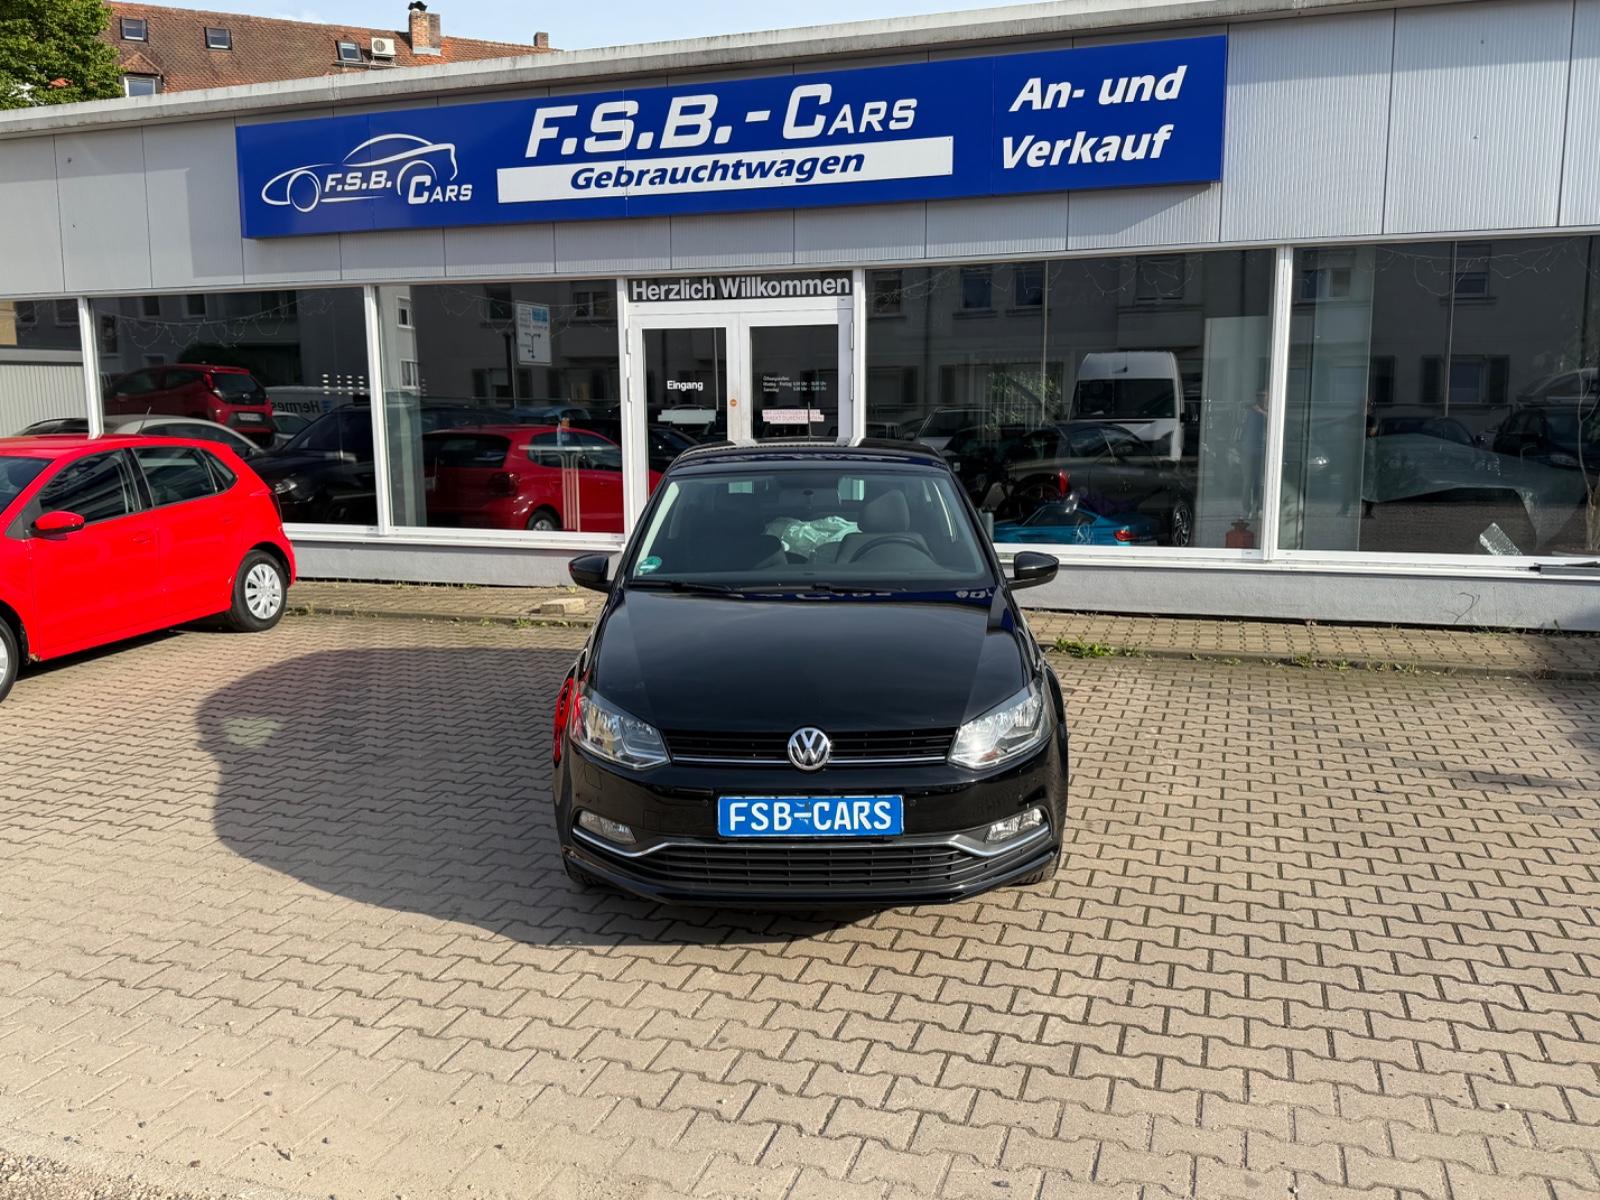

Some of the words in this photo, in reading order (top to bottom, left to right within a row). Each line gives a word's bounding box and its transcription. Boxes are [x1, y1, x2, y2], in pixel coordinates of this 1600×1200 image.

[1009, 77, 1085, 112] An-
[1098, 64, 1187, 105] und
[1001, 124, 1174, 170] Verkauf
[324, 170, 392, 194] F.S.B.
[570, 151, 866, 190] Gebrauchtwagen
[632, 278, 716, 301] Herzlich
[719, 276, 850, 299] Willkommen
[667, 380, 704, 391] Eingang
